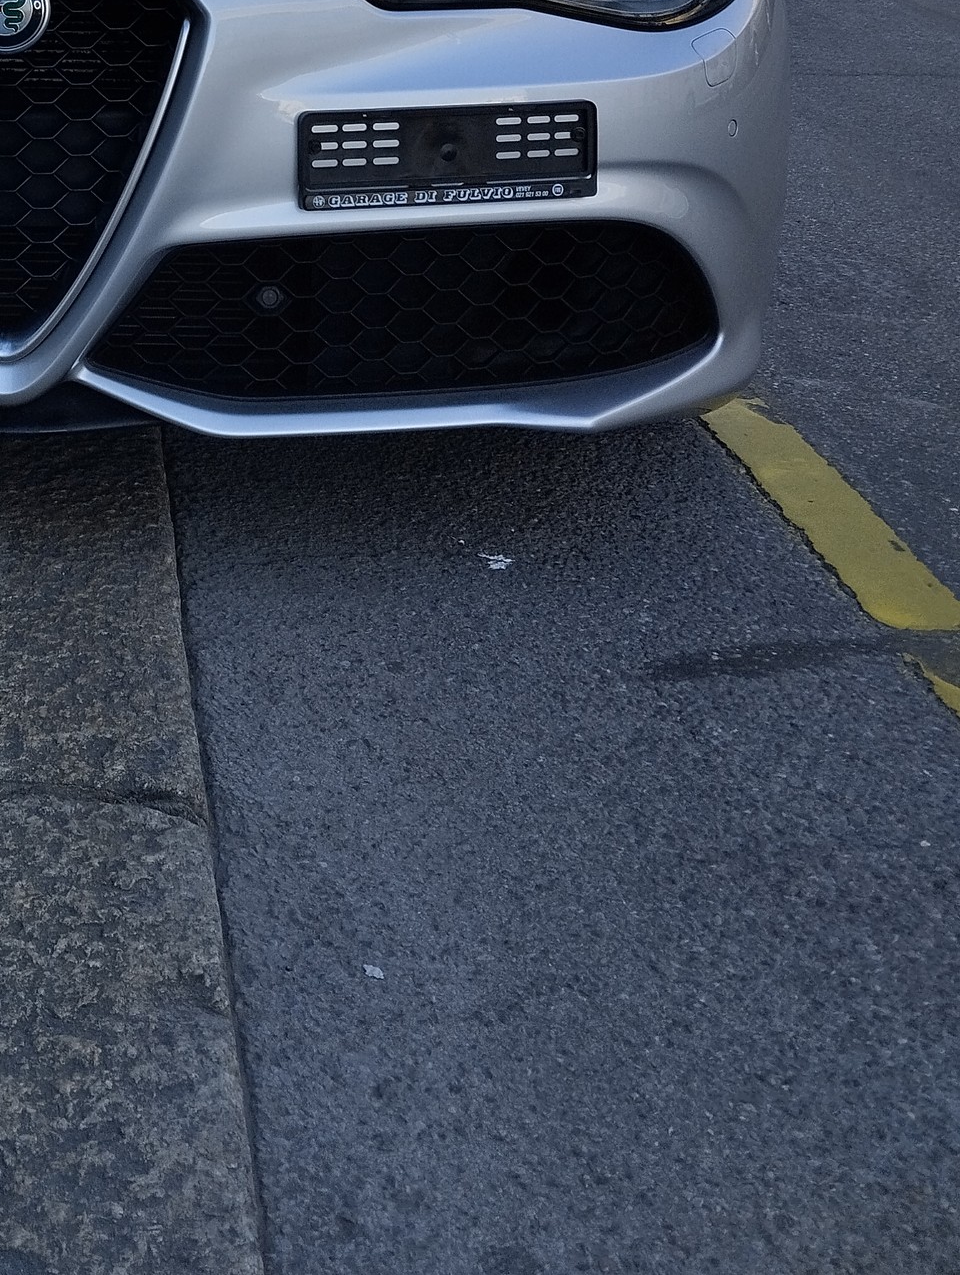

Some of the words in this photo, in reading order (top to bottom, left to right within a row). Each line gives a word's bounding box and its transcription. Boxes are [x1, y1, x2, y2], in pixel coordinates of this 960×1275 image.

[328, 192, 408, 208] GARAGE
[414, 190, 437, 203] DI
[443, 187, 514, 202] FULVIO
